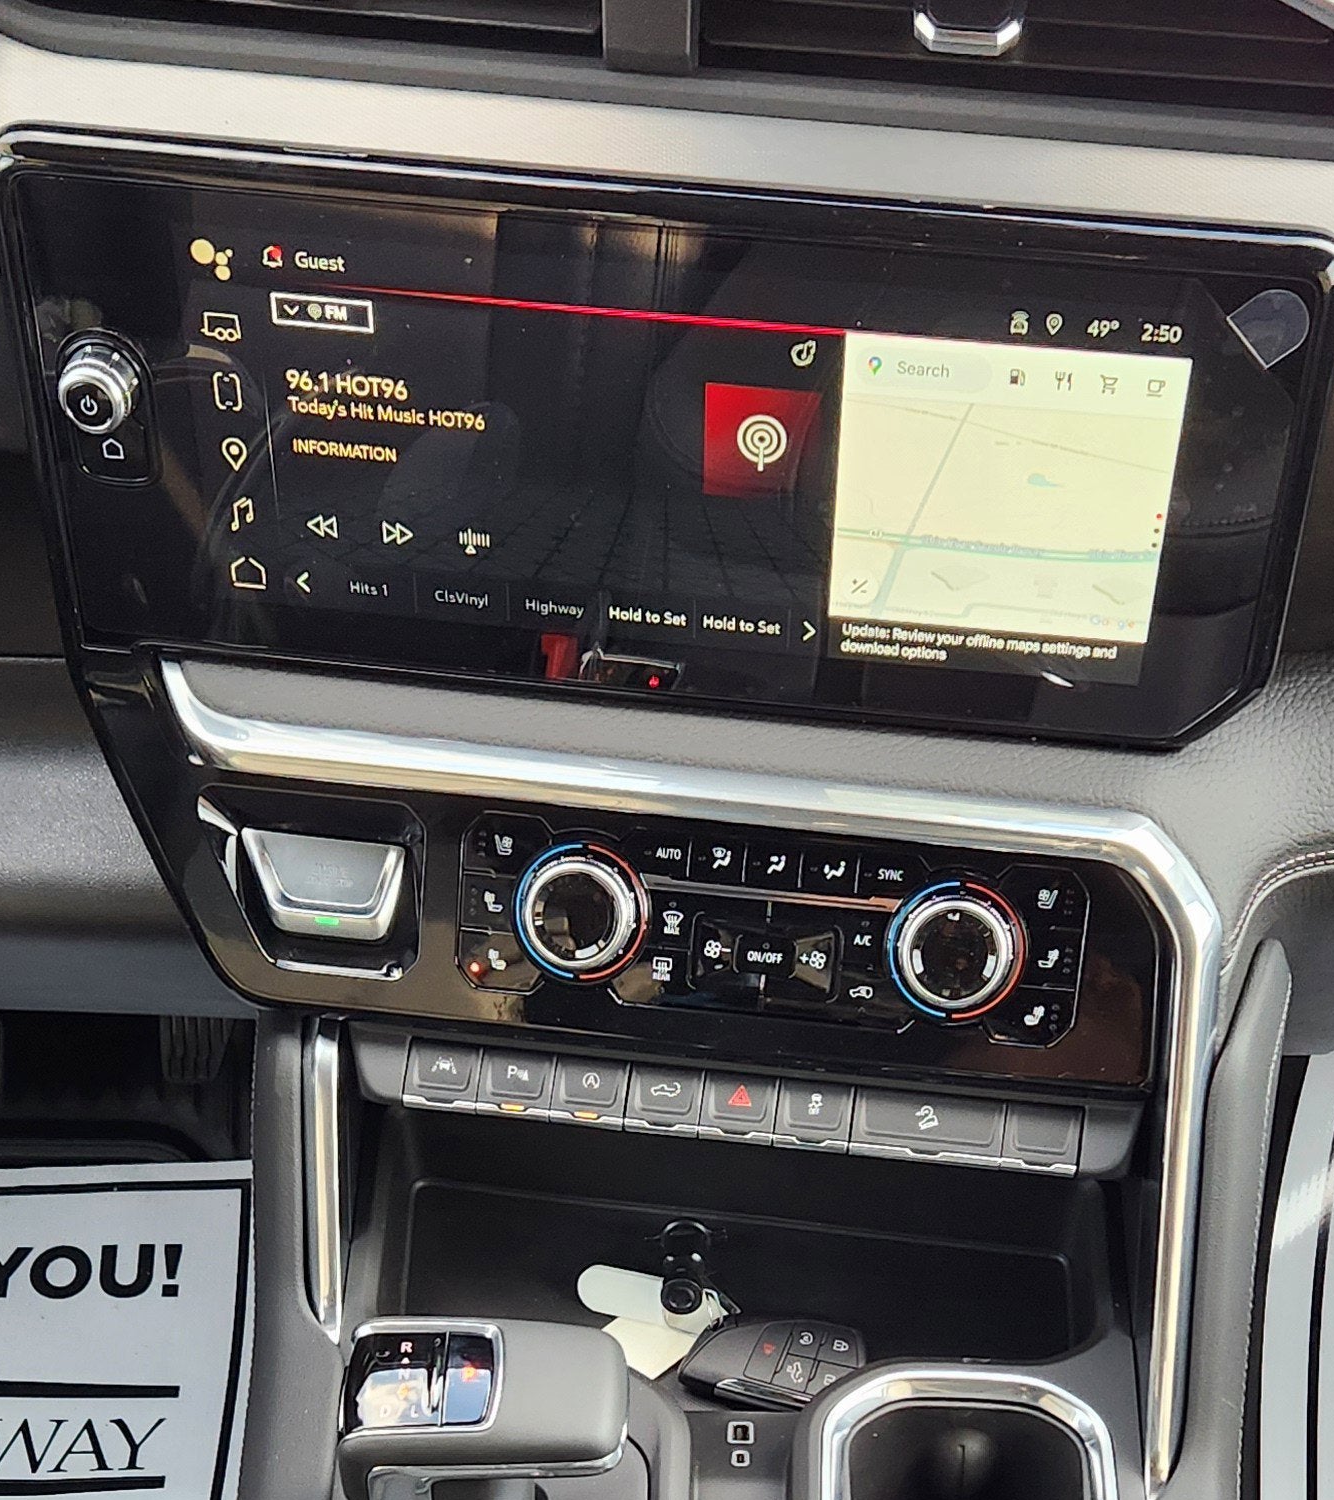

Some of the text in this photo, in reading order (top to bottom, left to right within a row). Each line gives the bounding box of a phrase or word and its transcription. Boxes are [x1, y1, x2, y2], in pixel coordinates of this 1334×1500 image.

[295, 252, 345, 273] Guest
[325, 306, 348, 321] FM
[1141, 323, 1183, 343] 2:50
[897, 361, 950, 380] Search
[285, 369, 408, 401] 96.1 HOT96
[287, 396, 486, 432] Today's Hit Music HOT96
[292, 438, 397, 462] INFORMATION
[350, 580, 377, 596] Hits
[434, 589, 489, 609] ClsVinyl
[524, 597, 585, 621] Highway
[608, 605, 687, 628] Hold to Set
[702, 614, 781, 637] Hold to Set
[840, 640, 948, 662] download options
[842, 623, 1118, 661] Update: Review your offline maps settings and
[655, 847, 682, 861] AUTO
[877, 869, 904, 882] SYNC
[853, 934, 873, 948] A/C
[746, 950, 784, 965] ON/OFF
[400, 1341, 414, 1354] R
